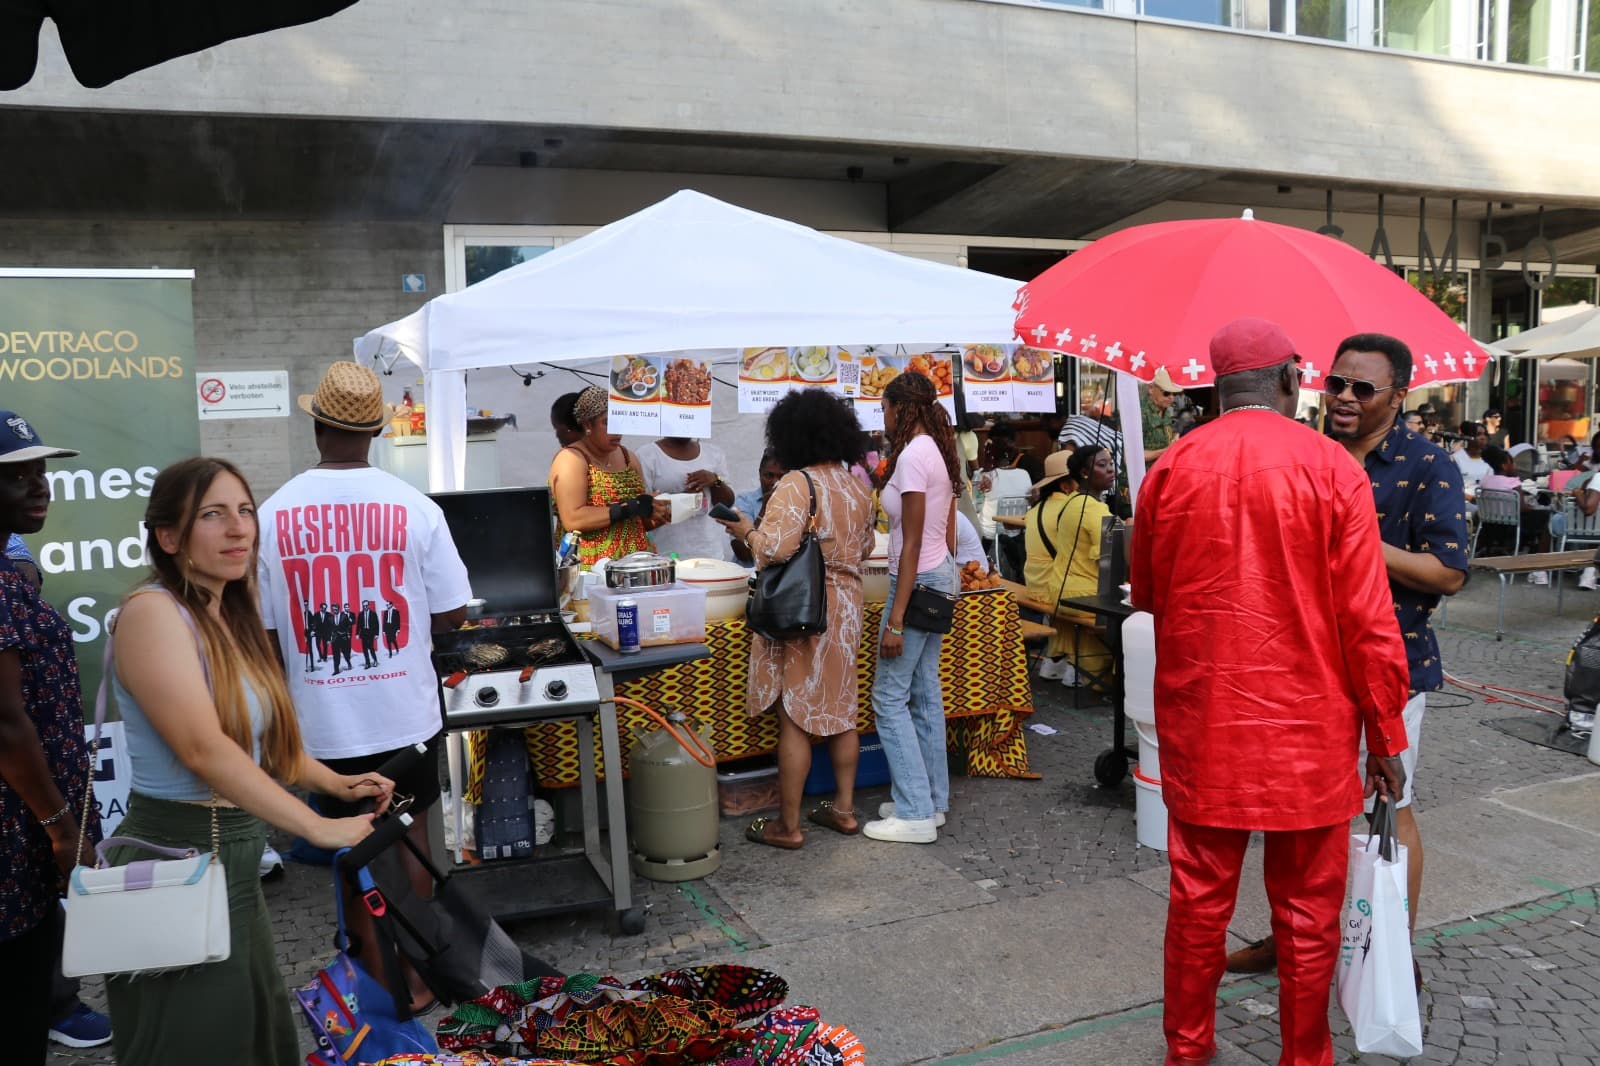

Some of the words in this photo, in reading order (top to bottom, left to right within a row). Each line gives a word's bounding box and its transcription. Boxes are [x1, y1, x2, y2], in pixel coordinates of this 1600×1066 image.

[1316, 224, 1557, 291] AMPO
[40, 520, 152, 574] and
[276, 503, 407, 558] RESERVOIR
[282, 552, 410, 656] DOGS
[327, 677, 346, 685] GO
[347, 675, 366, 683] TO
[369, 671, 407, 681] WORK
